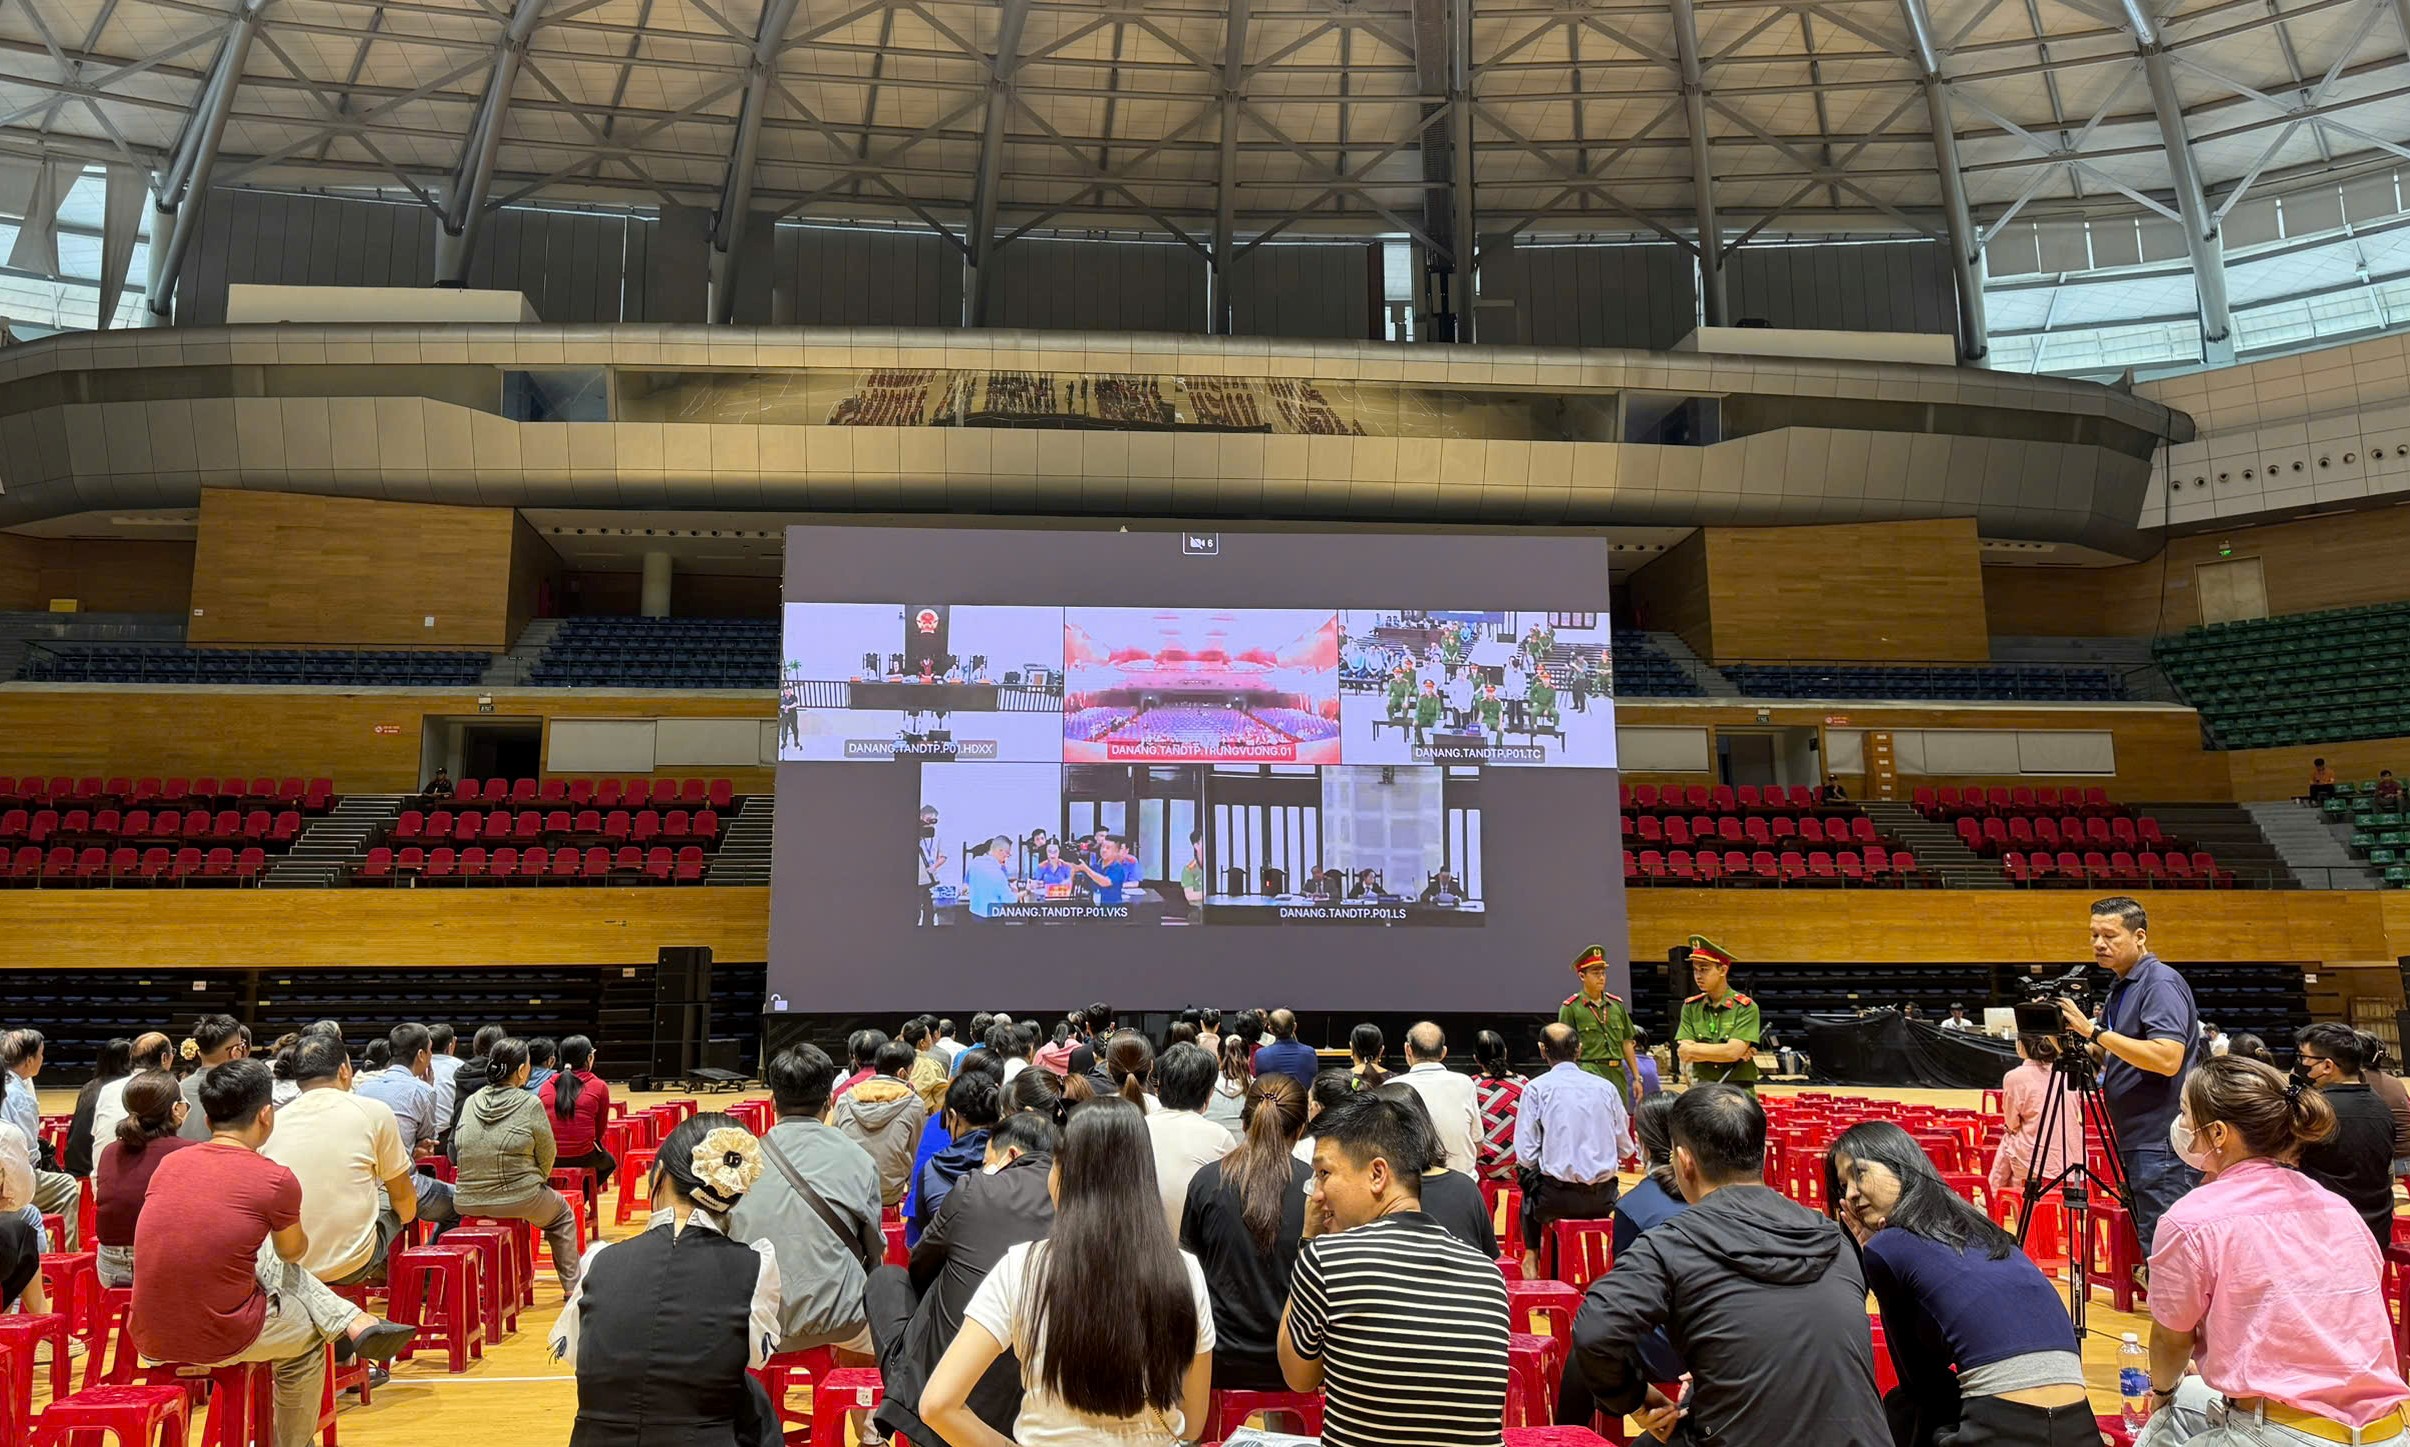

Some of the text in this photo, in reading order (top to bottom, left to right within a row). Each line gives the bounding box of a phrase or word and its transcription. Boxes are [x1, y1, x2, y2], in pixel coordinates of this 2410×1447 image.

[1207, 539, 1214, 548] 6
[1111, 744, 1292, 757] DANANG.TANDTP.TRUNGVUONG.01
[1415, 748, 1541, 759] DANANG.TANDTP.P01.TC
[991, 906, 1128, 918] DANANG.TANDTP.P01.VKS
[1279, 907, 1407, 919] DANANG.TANDTP.P01.LS
